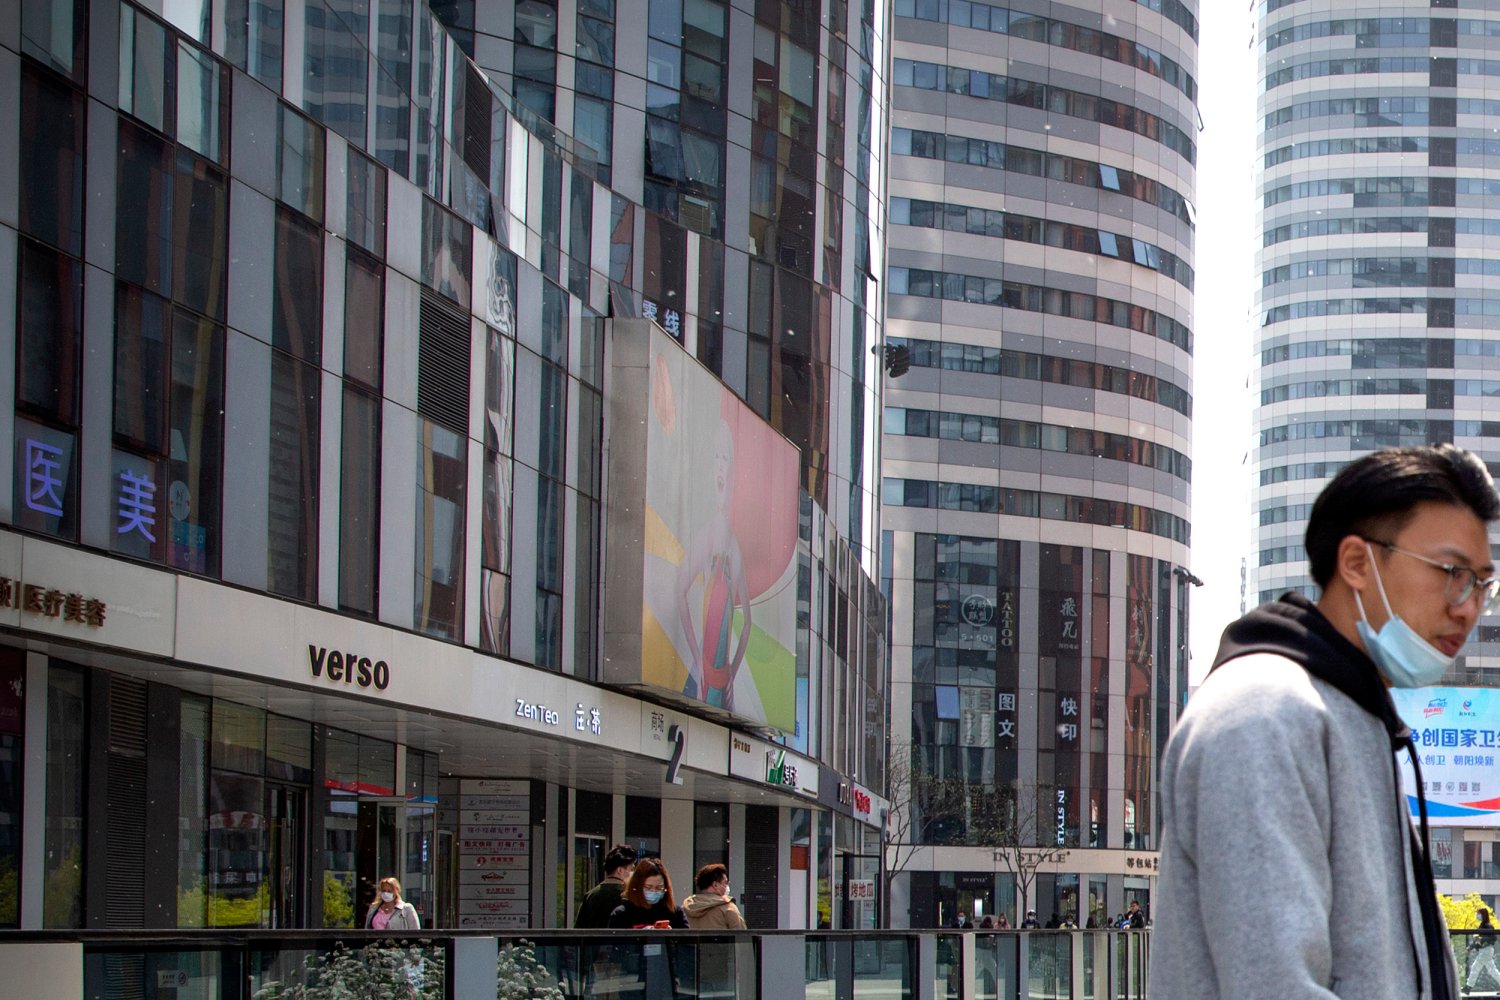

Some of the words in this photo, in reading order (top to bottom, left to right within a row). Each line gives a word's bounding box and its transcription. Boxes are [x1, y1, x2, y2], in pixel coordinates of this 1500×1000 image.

[26, 438, 156, 543] 医美
[24, 583, 106, 627] 医疗美容
[1002, 592, 1014, 647] TATTOO
[308, 644, 390, 690] verso
[998, 693, 1016, 738] 图文
[1060, 697, 1078, 741] 快印
[666, 724, 685, 785] 2
[1057, 790, 1065, 804] IN
[1057, 807, 1065, 845] STYLE
[850, 882, 874, 898] 烤地瓜
